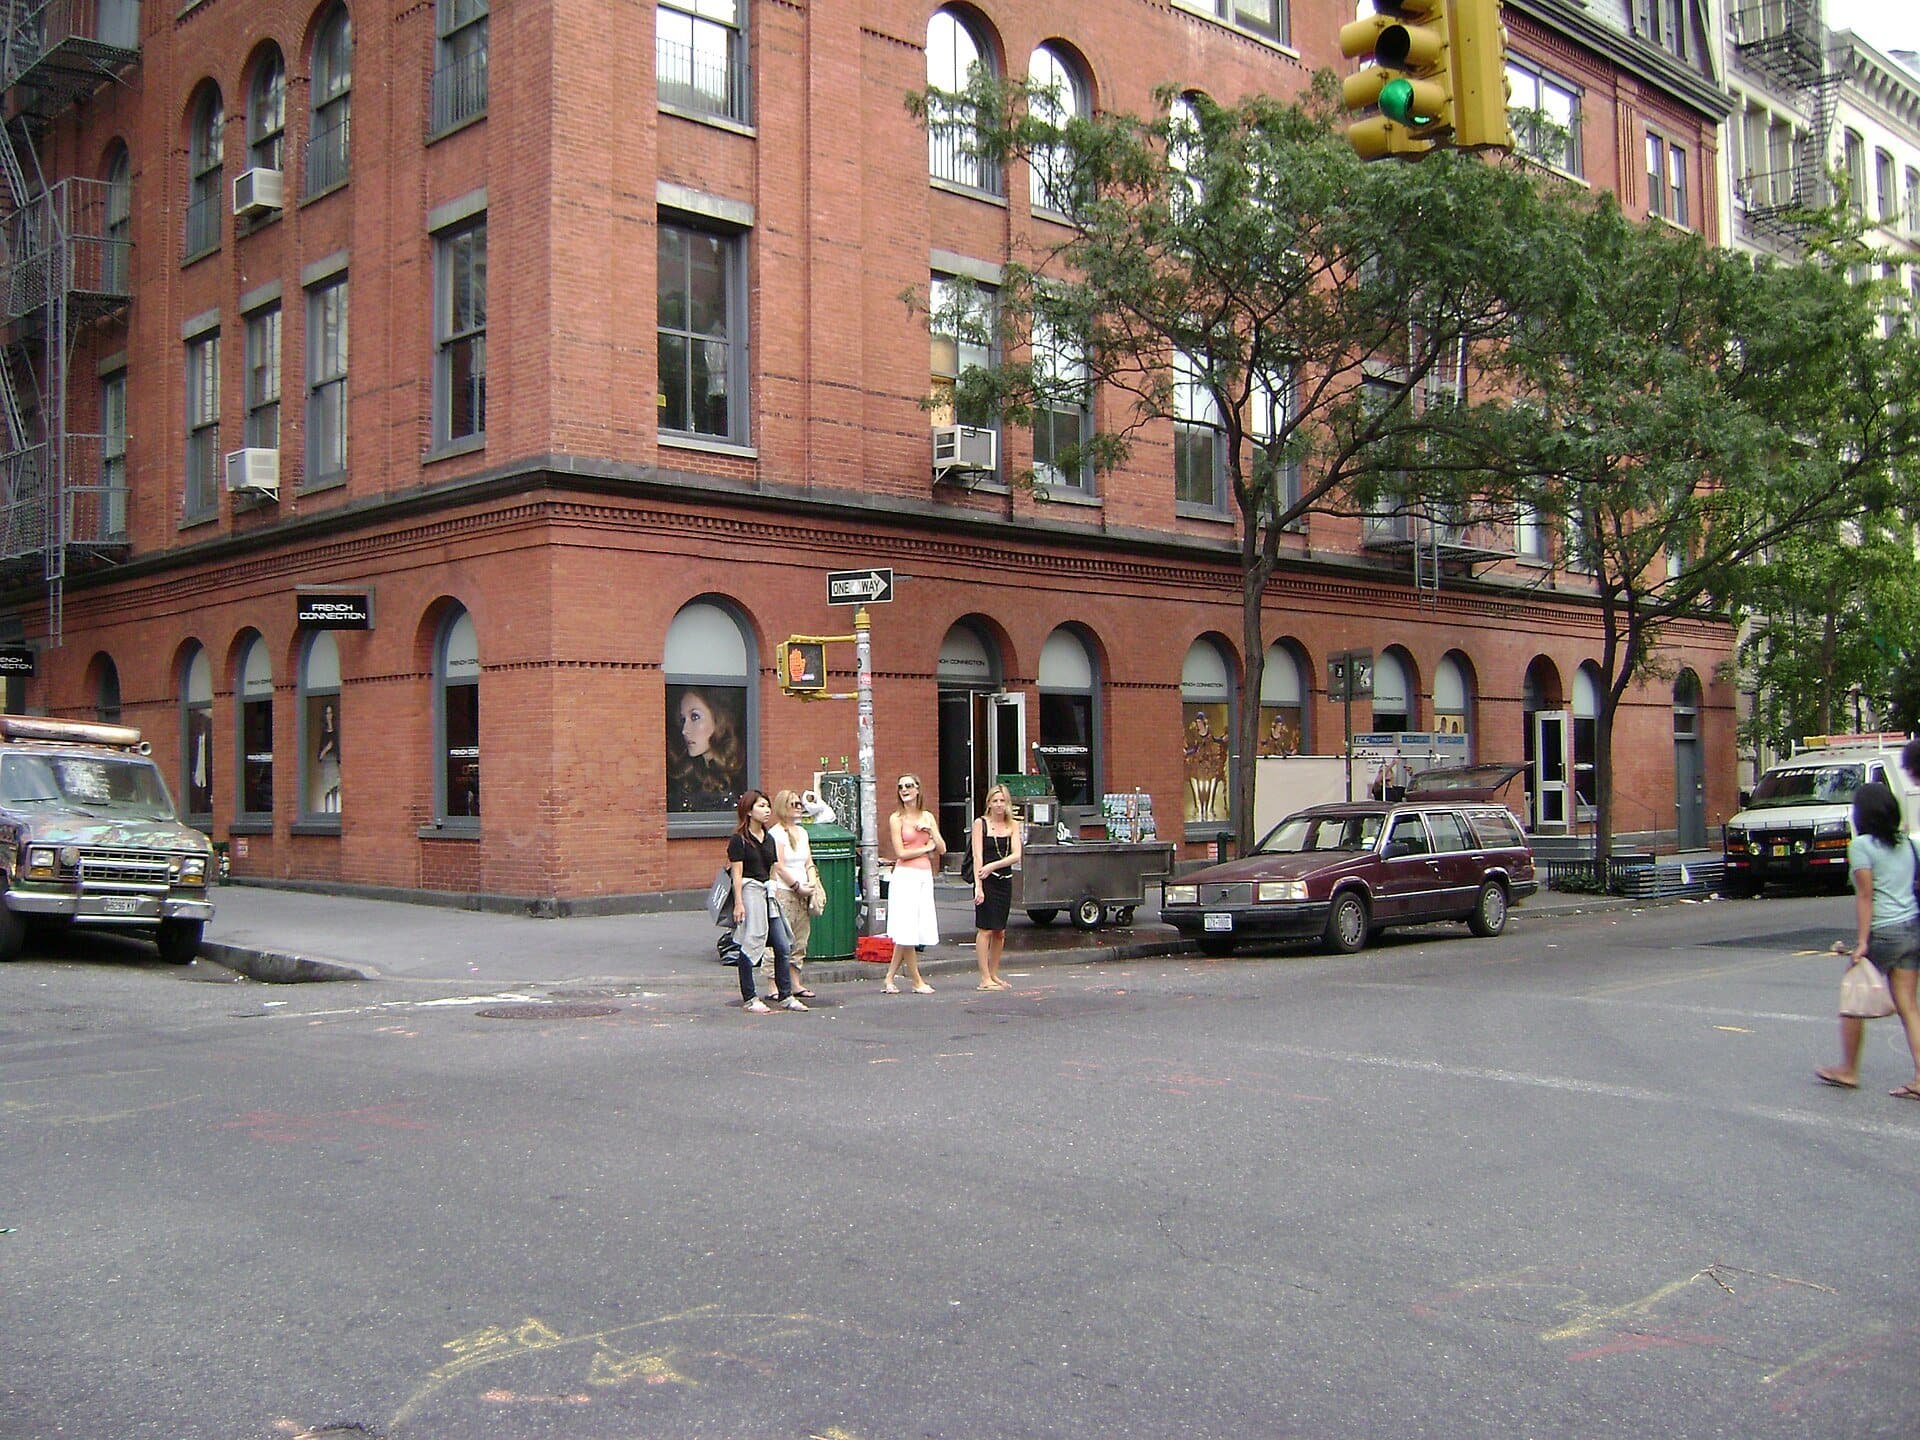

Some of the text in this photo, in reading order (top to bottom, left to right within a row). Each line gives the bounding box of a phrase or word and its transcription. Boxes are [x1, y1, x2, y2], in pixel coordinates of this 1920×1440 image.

[832, 580, 880, 595] ONE WAY
[311, 604, 353, 612] FRENCH
[299, 612, 366, 620] CONNECTION
